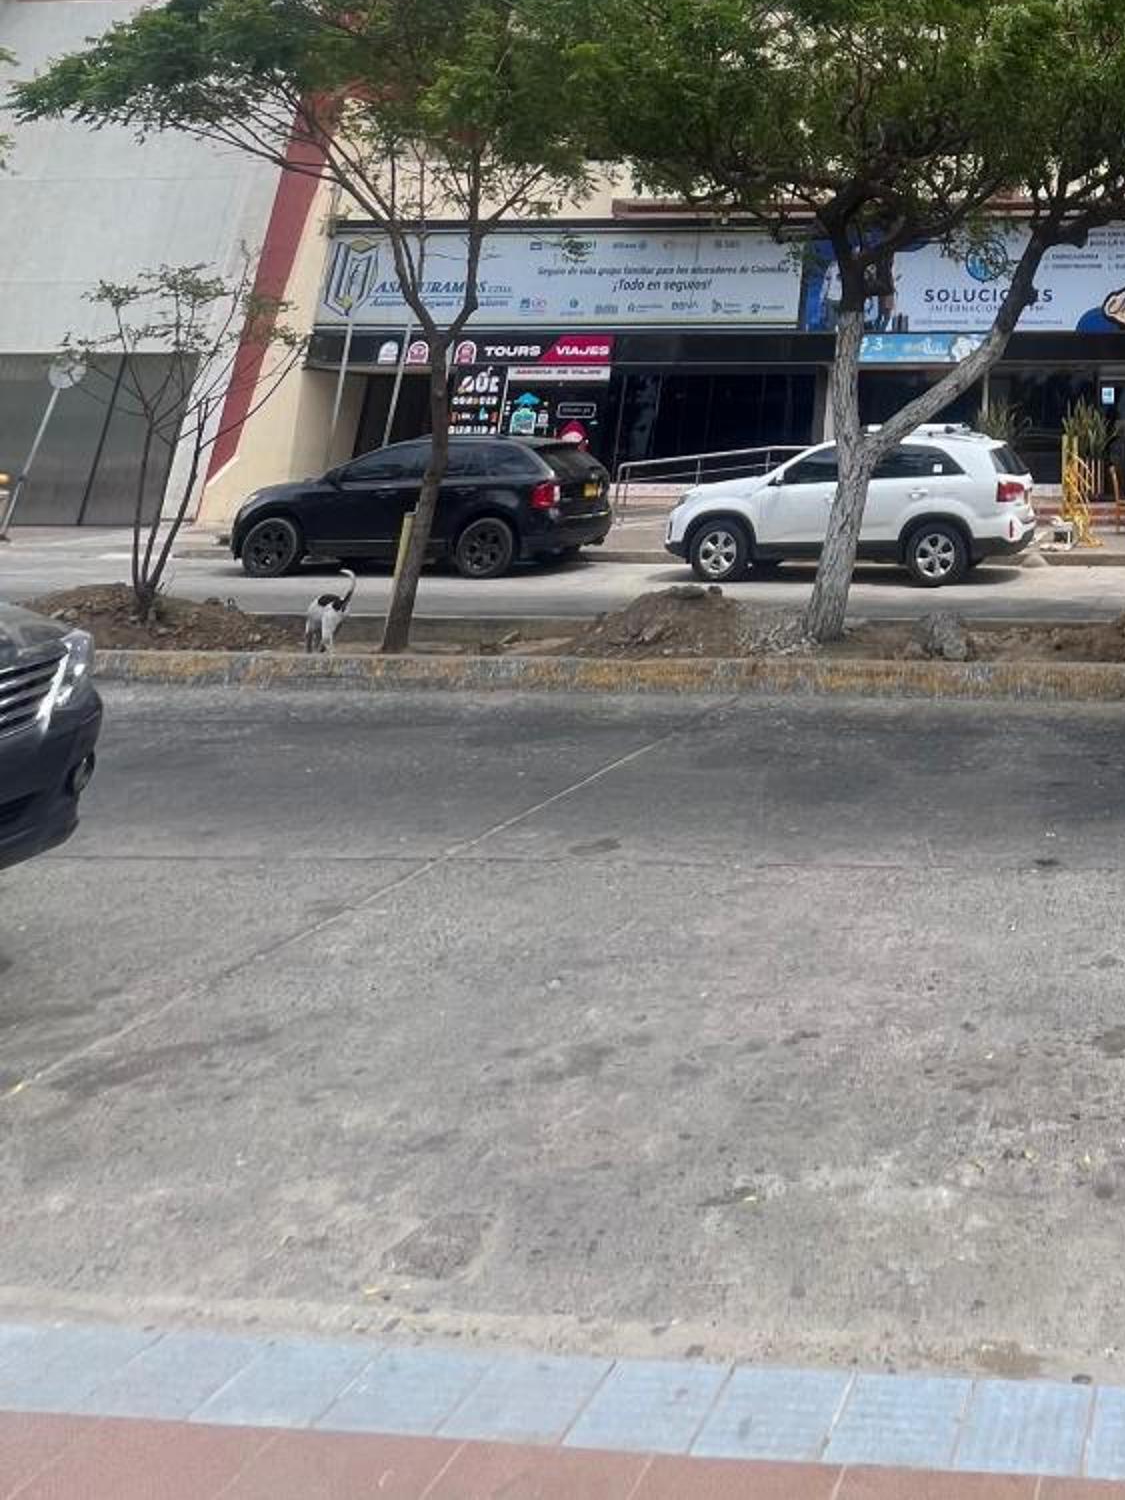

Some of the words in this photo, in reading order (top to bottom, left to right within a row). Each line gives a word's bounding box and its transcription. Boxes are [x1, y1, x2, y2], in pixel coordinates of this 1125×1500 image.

[647, 281, 660, 291] en
[924, 289, 1053, 302] SOLUCIOS
[484, 345, 542, 357] TOURS
[555, 345, 609, 357] VIAJES
